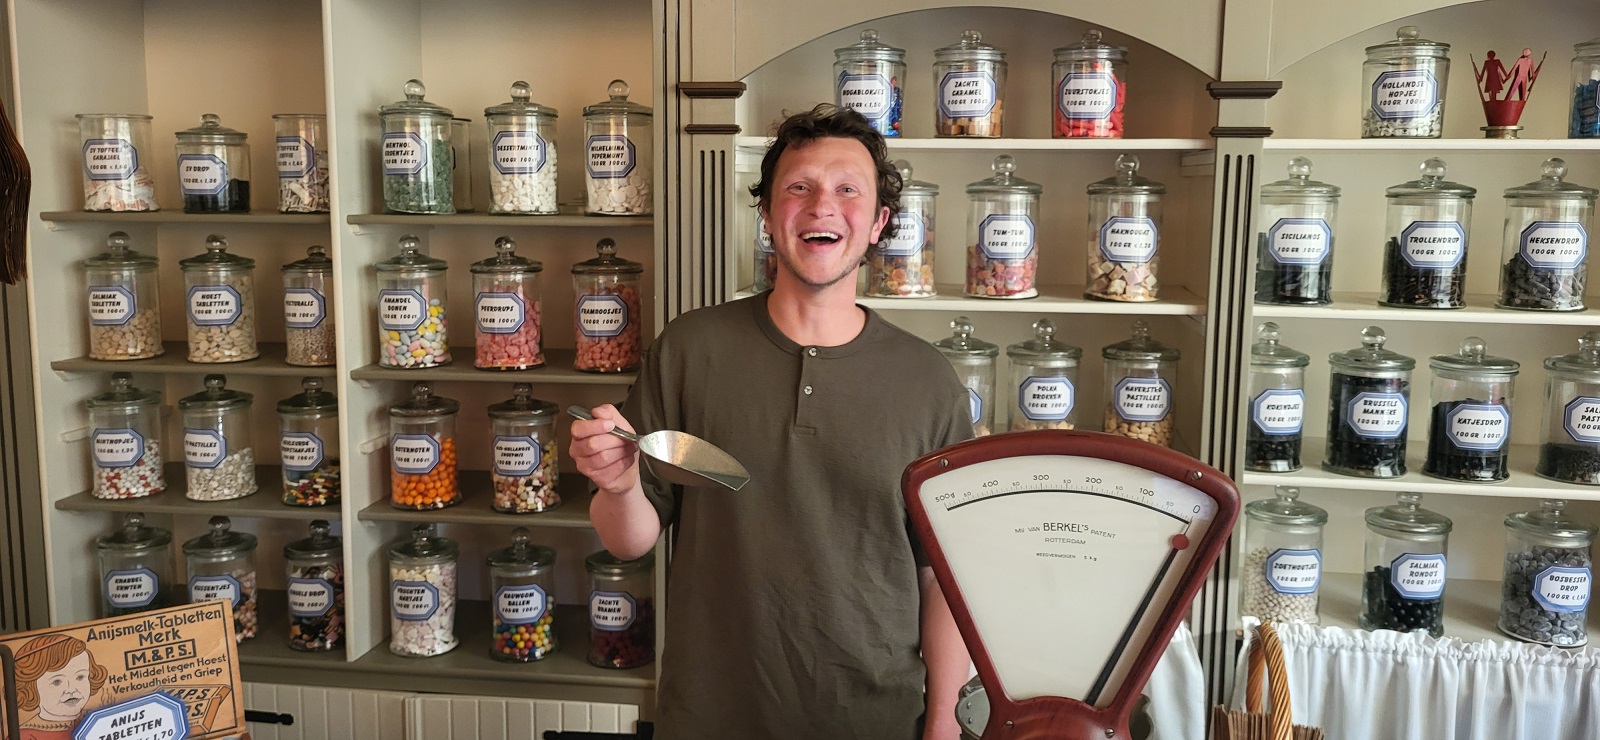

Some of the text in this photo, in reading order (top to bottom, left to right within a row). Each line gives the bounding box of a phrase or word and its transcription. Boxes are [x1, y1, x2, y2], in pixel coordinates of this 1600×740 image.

[1382, 81, 1424, 89] HOLLANDSE
[935, 493, 955, 502] 500g
[1140, 488, 1154, 496] 100
[1193, 505, 1200, 514] 0
[1043, 523, 1089, 533] BERKEL'S
[1091, 530, 1116, 539] PATENT
[1550, 575, 1587, 583] BOSBESSEN
[86, 610, 222, 642] Anijsmelk-Tabletten
[138, 628, 182, 646] Merk
[109, 653, 226, 684] Het Middel tegen Hoest
[112, 675, 177, 694] Verkoudheid
[195, 667, 222, 678] Griep
[99, 718, 162, 740] TABLETTEN
[111, 710, 145, 728] ANIJS
